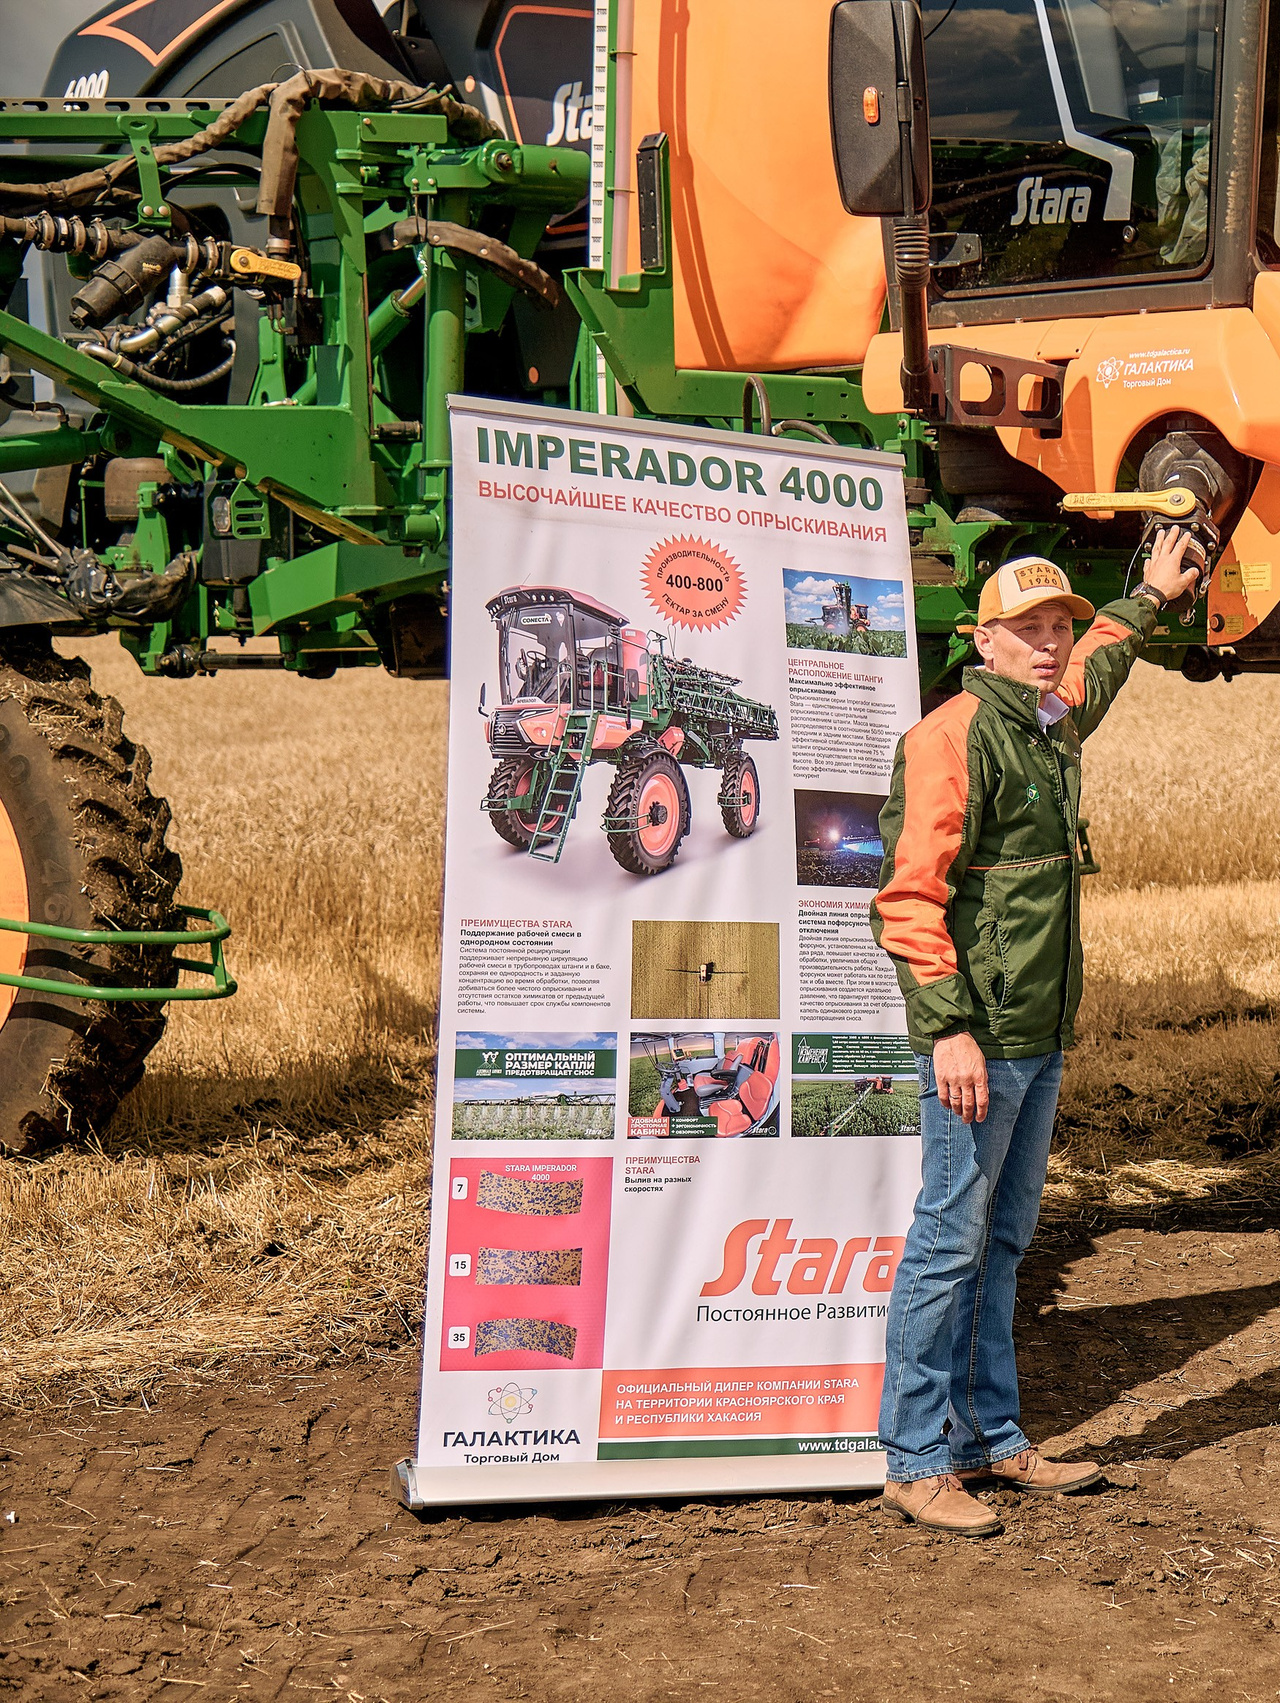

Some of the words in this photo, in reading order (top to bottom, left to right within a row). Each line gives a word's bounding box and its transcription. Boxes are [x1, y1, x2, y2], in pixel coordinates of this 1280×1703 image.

[1010, 176, 1092, 226] Stara
[1129, 348, 1190, 359] www.tdgalactica.ru
[1123, 359, 1194, 376] ГАЛАКТИКА
[1123, 378, 1156, 389] Торговый
[1156, 377, 1171, 387] Дом
[477, 427, 766, 496] IMPERADOR
[779, 467, 884, 511] 4000
[478, 480, 626, 512] ВЫСОЧАЙШЕЕ
[632, 498, 731, 525] КАЧЕСТВО
[737, 509, 887, 542] ОПРЫСКИВАНИЯ
[657, 550, 730, 582] ПРОИЗВОДИТЕЛЬНОСТЬ
[1019, 566, 1059, 577] STARA
[666, 574, 723, 592] 400-800
[1028, 577, 1058, 586] 1960
[662, 593, 690, 615] ГЕКТАР
[705, 597, 729, 617] СМЕНУ
[522, 616, 550, 624] CONECTA
[788, 658, 844, 671] ЦЕНТРАЛЬНОЕ
[788, 668, 852, 680] РАСПОЛОЖЕНИЕ
[853, 673, 883, 683] ШТАНГИ
[788, 677, 833, 687] Максимально
[834, 683, 876, 692] эффективное
[789, 687, 836, 696] опрыскивание
[798, 900, 843, 908] ЭКОНОМИЯ
[798, 910, 828, 918] Двойная
[460, 919, 540, 929] ПРЕИМУЩЕСТВА
[542, 920, 572, 928] STARA
[460, 929, 515, 937] Поддержание
[516, 930, 549, 938] рабочей
[513, 962, 560, 970] трубопроводах
[545, 1000, 570, 1008] службы
[505, 1051, 596, 1062] ОПТИМАЛЬНЫЙ
[505, 1061, 553, 1069] РАЗМЕР
[555, 1061, 595, 1069] КАПЛИ
[505, 1069, 572, 1077] ПРЕДОТВРАЩАЕТ
[630, 1128, 667, 1136] КАБИНА
[625, 1155, 700, 1166] ПРЕИМУЩЕСТВА
[505, 1164, 531, 1172] STARA
[532, 1164, 577, 1172] IMPERADOR
[625, 1166, 655, 1175] STARA
[531, 1173, 550, 1181] 4000
[625, 1176, 650, 1184] Вылив
[664, 1176, 692, 1186] разных
[457, 1184, 464, 1193] 7
[624, 1186, 664, 1194] скоростях
[699, 1218, 906, 1297] Stara
[455, 1261, 467, 1270] 15
[697, 1304, 811, 1322] Постоянное
[453, 1333, 466, 1342] 35
[617, 1380, 712, 1396] ОФИЦИАЛЬНЫЙ
[714, 1381, 754, 1394] ДИЛЕР
[756, 1379, 821, 1392] КОМПАНИИ
[823, 1378, 860, 1389] STARA
[616, 1398, 633, 1410] НА
[636, 1397, 713, 1409] ТЕРРИТОРИИ
[716, 1395, 815, 1407] КРАСНОЯРСКОГО
[817, 1394, 845, 1405] КРАЯ
[615, 1415, 624, 1425] И
[626, 1413, 704, 1425] РЕСПУБЛИКИ
[706, 1411, 762, 1423] ХАКАСИЯ
[443, 1429, 581, 1447] ГАЛАКТИКА
[464, 1452, 528, 1465] Торговый
[532, 1452, 560, 1463] Дом
